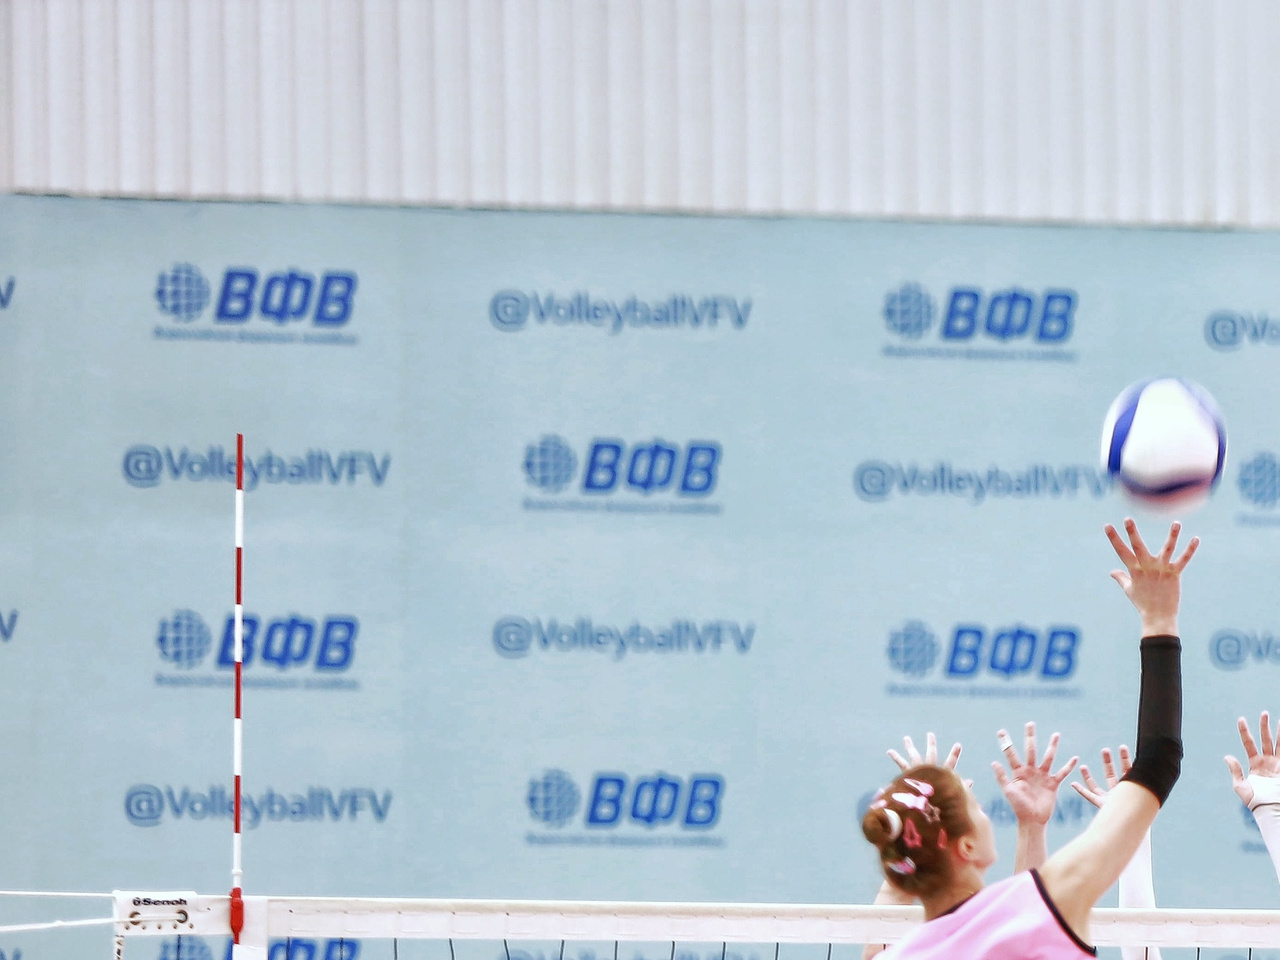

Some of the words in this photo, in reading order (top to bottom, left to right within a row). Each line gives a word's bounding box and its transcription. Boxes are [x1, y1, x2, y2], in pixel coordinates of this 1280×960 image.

[213, 268, 359, 327] ВФВ
[489, 290, 752, 335] @VolleyballVFV
[937, 286, 1078, 344] ВФВ
[582, 440, 722, 497] ВФВ
[216, 610, 360, 672] ВФВ
[492, 617, 755, 659] @VolleyballVFV
[939, 625, 1081, 681] ВФВ
[585, 774, 724, 829] ВФВ
